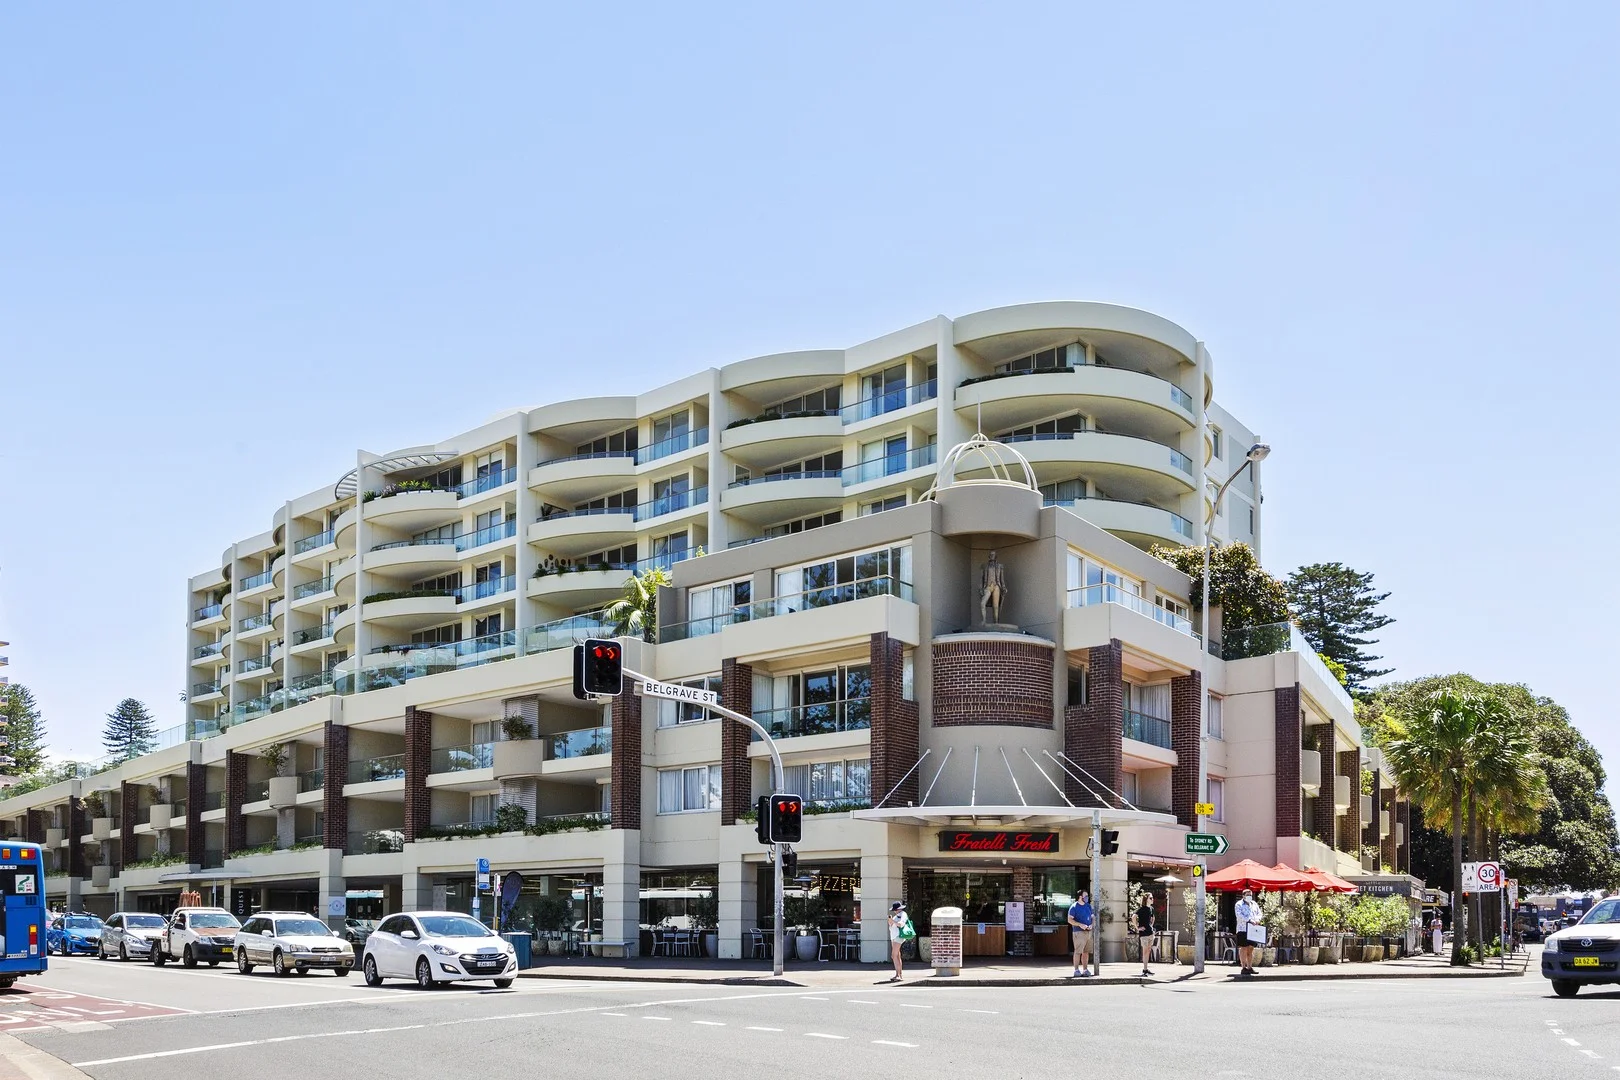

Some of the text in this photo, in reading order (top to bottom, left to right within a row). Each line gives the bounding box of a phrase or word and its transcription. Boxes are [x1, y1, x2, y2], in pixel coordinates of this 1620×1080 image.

[646, 682, 715, 702] BELGRAVE ST
[950, 833, 1054, 851] Fratelli Fresh
[1481, 869, 1495, 878] 30
